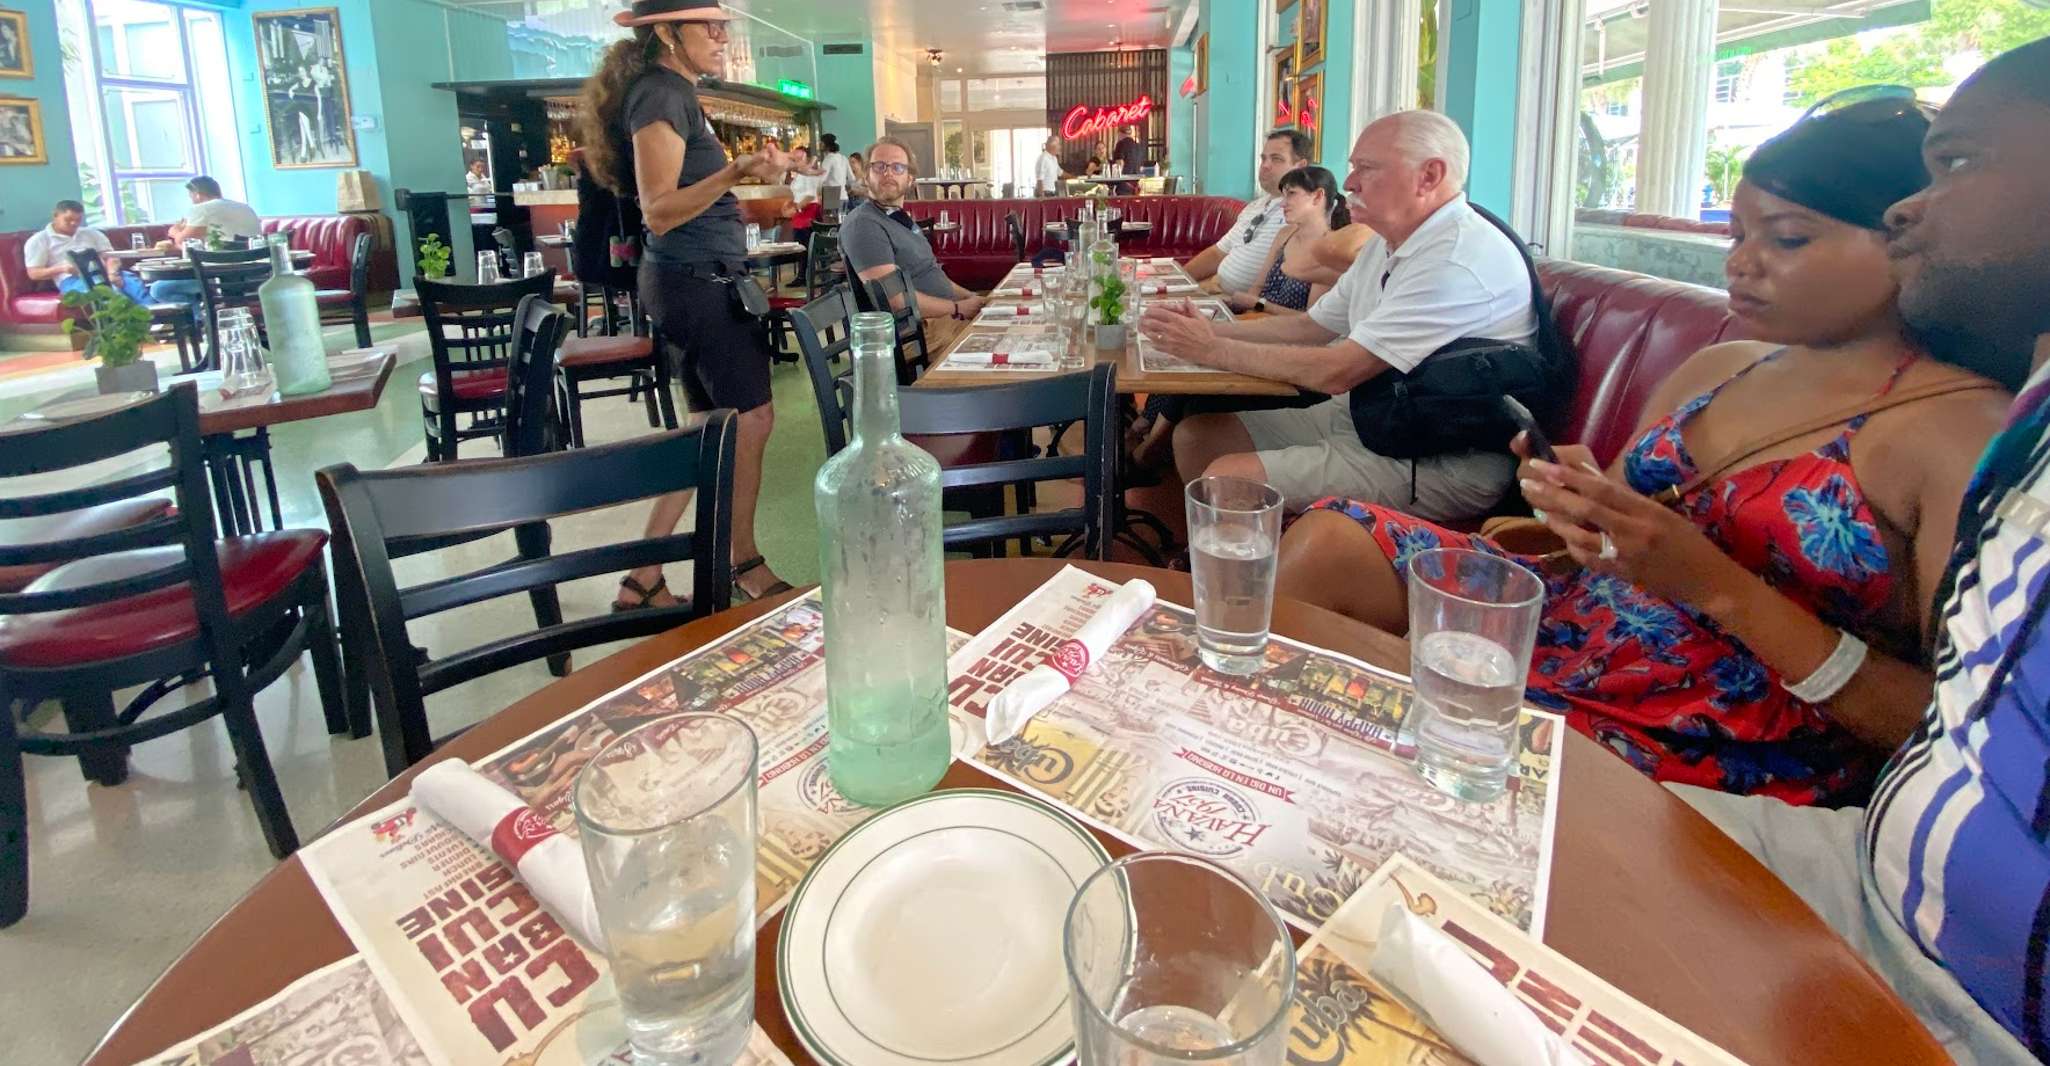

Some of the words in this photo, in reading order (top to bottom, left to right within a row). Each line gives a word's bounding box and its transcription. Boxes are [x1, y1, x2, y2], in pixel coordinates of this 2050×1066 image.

[1062, 94, 1151, 140] Cabaret
[1169, 794, 1228, 815] 1957
[1268, 784, 1283, 797] UN
[1152, 797, 1272, 847] HAVANA
[423, 860, 485, 900] BREAKFAST
[431, 847, 471, 872] DINNER
[442, 853, 478, 877] LUNCH
[396, 861, 514, 940] SINE
[416, 881, 539, 973] CUI
[440, 911, 565, 1006] BAN
[467, 938, 600, 1053] CU
